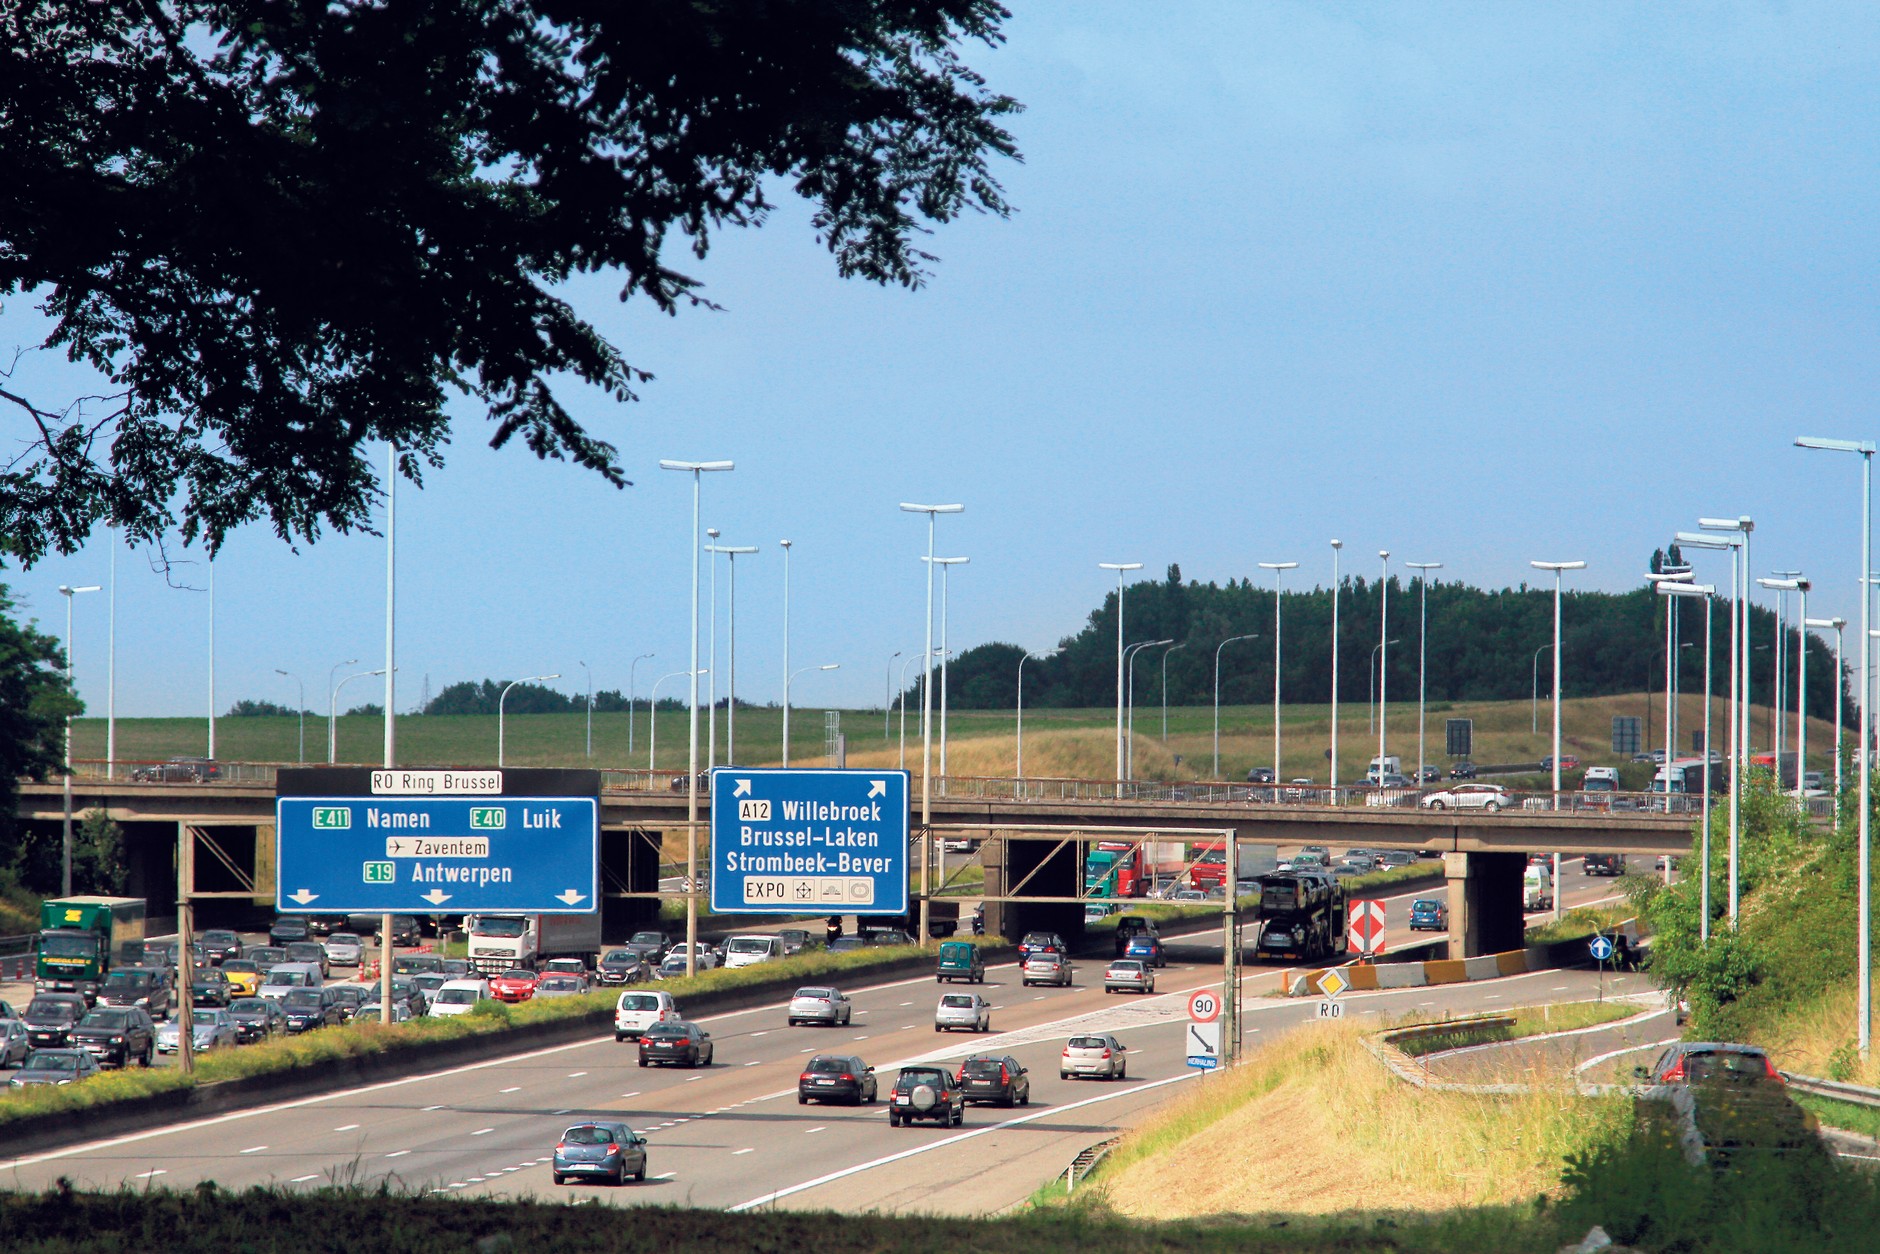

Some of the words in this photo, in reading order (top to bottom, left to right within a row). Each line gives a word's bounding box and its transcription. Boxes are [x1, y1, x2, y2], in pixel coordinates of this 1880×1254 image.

[402, 773, 435, 793] Ring
[444, 773, 500, 790] Brussel
[315, 810, 349, 827] E411
[367, 808, 430, 828] Namen
[472, 810, 503, 827] E40
[523, 808, 562, 829] Luik
[742, 803, 768, 818] A12
[782, 800, 881, 822] Willebroek
[740, 826, 878, 847] Brussel-Laken
[415, 840, 487, 855] Zaventem
[726, 851, 892, 873] Strombeek-Bever
[365, 864, 392, 881] E19
[411, 862, 512, 887] Antwerpen
[746, 882, 785, 898] EXPO
[1195, 999, 1213, 1013] 90
